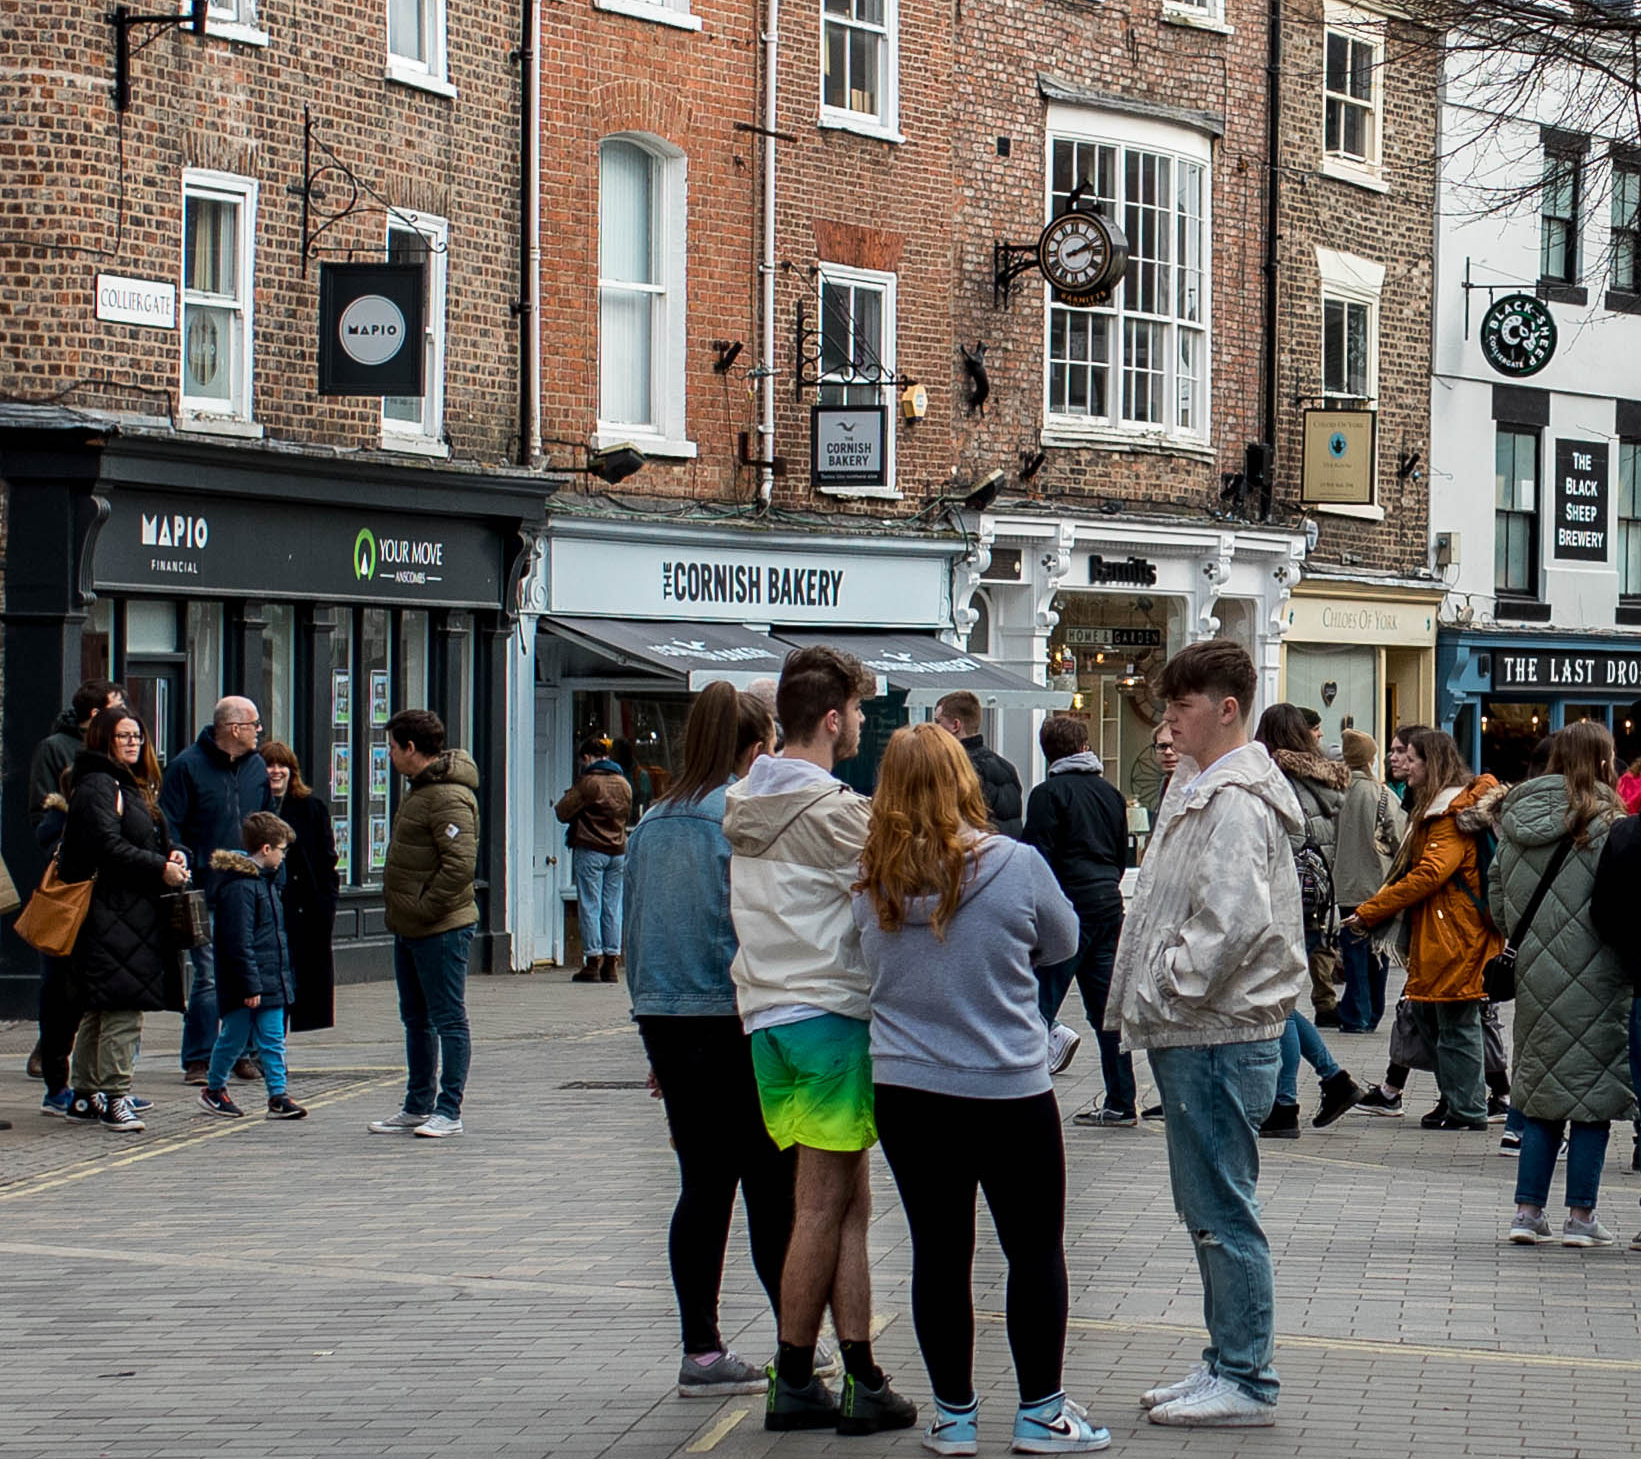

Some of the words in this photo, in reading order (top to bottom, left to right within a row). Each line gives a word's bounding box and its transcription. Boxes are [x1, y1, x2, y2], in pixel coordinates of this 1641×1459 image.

[101, 288, 171, 315] COLLIERGATE
[348, 325, 397, 335] MAPIO
[1489, 301, 1533, 329] BLACK
[1529, 316, 1549, 366] SHEEP
[827, 443, 871, 453] CORNISH
[829, 455, 869, 466] BAKERY
[1572, 452, 1592, 471] THE
[1566, 477, 1598, 497] BLACK
[1566, 502, 1597, 522] SHEEP
[141, 513, 208, 550] MAPIO
[1559, 528, 1604, 548] BREWERY
[379, 538, 409, 564] YOUR
[411, 542, 443, 566] MOVE
[151, 560, 198, 574] FINANCIAL
[663, 562, 672, 600] THE
[674, 562, 761, 604] CORNISH
[768, 567, 843, 607] BAKERY
[1374, 610, 1398, 630] YORK
[1069, 629, 1098, 642] HOME
[1114, 631, 1158, 643] GARDEN
[1504, 657, 1538, 682] THE
[1550, 658, 1595, 684] LAST
